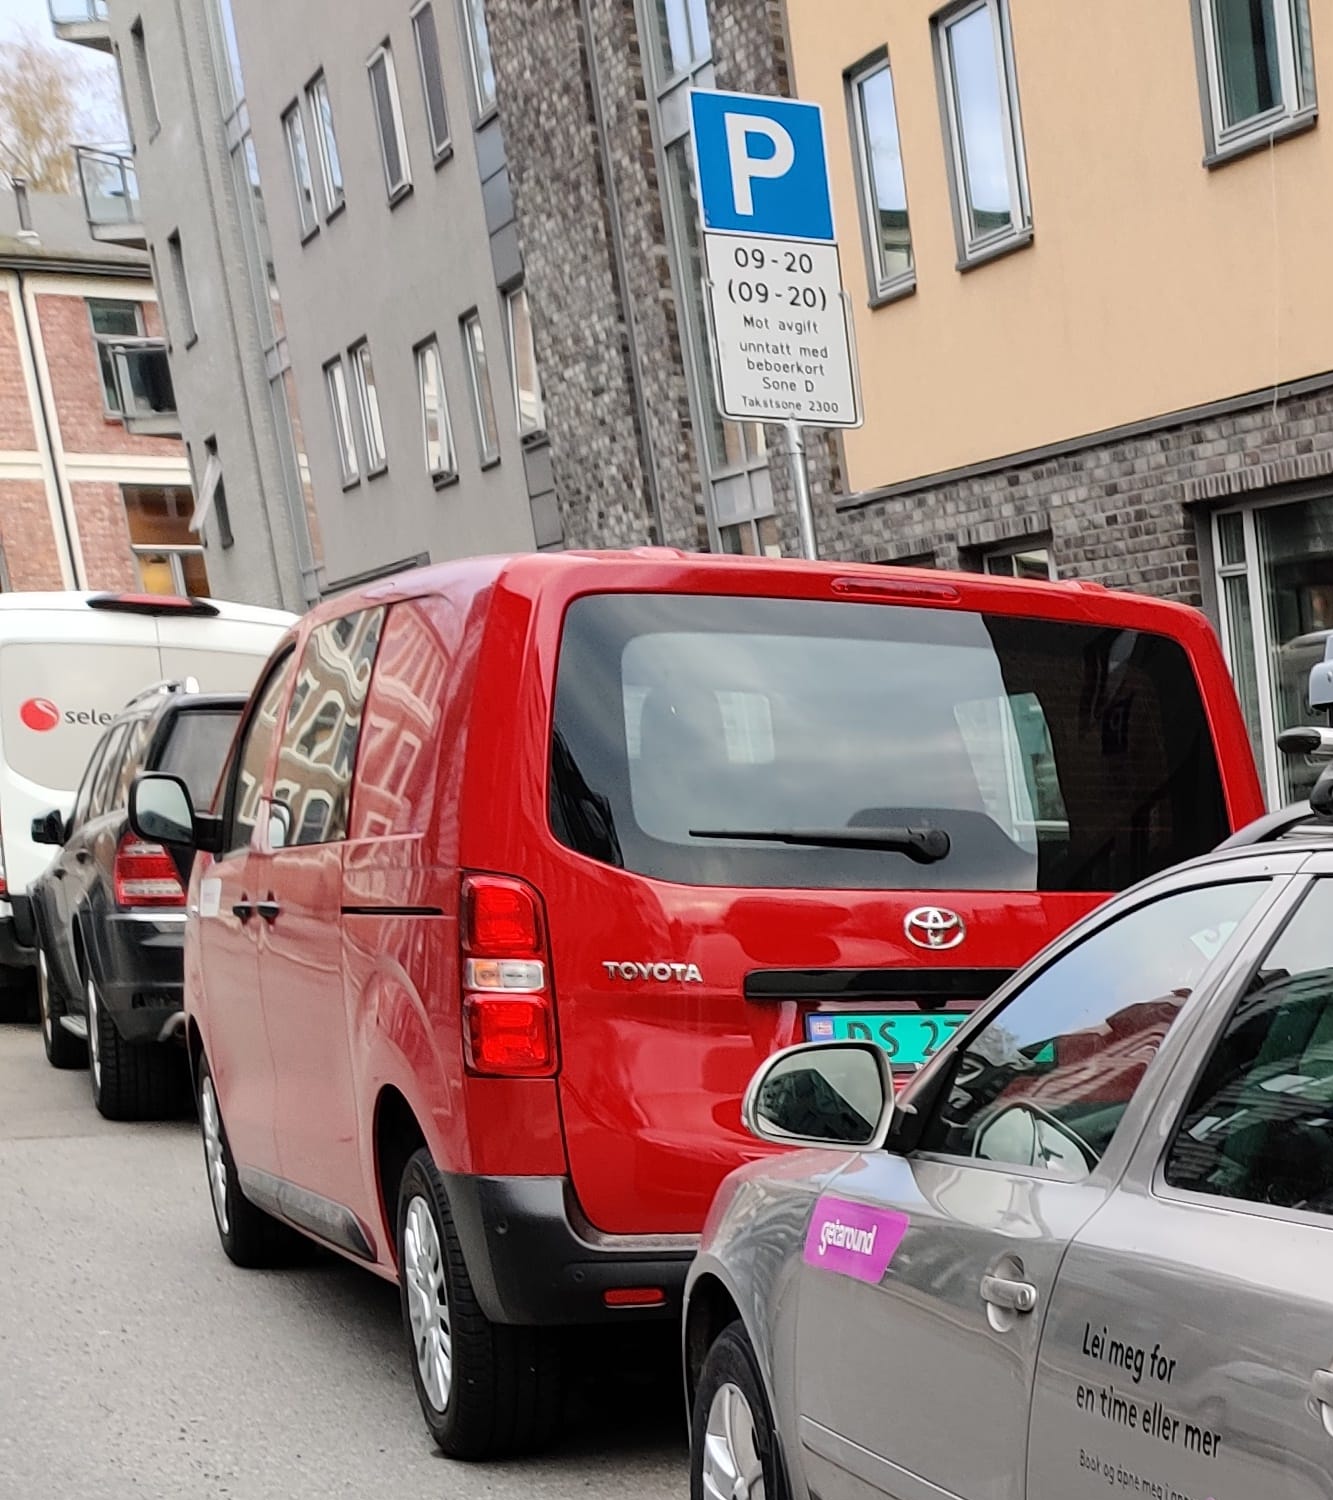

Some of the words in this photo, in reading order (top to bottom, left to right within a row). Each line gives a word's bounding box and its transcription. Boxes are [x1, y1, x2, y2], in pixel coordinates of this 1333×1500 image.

[724, 112, 795, 216] P
[743, 315, 770, 330] Mot
[778, 320, 819, 335] avgift
[739, 342, 792, 356] unntatt
[799, 346, 829, 358] med
[746, 357, 825, 376] beboerkort
[762, 376, 797, 392] Sone
[804, 380, 815, 393] D
[742, 395, 802, 411] Takstsone
[809, 400, 840, 413] 2300
[64, 708, 117, 726] sele
[602, 961, 704, 983] TOYOTA
[1082, 1322, 1107, 1360] Lei
[1109, 1340, 1145, 1384] meg
[1150, 1344, 1177, 1384] for
[1076, 1385, 1095, 1413] en
[1100, 1385, 1138, 1428] time
[1142, 1402, 1180, 1443] eller
[1185, 1424, 1221, 1458] mer
[1103, 1464, 1115, 1485] og
